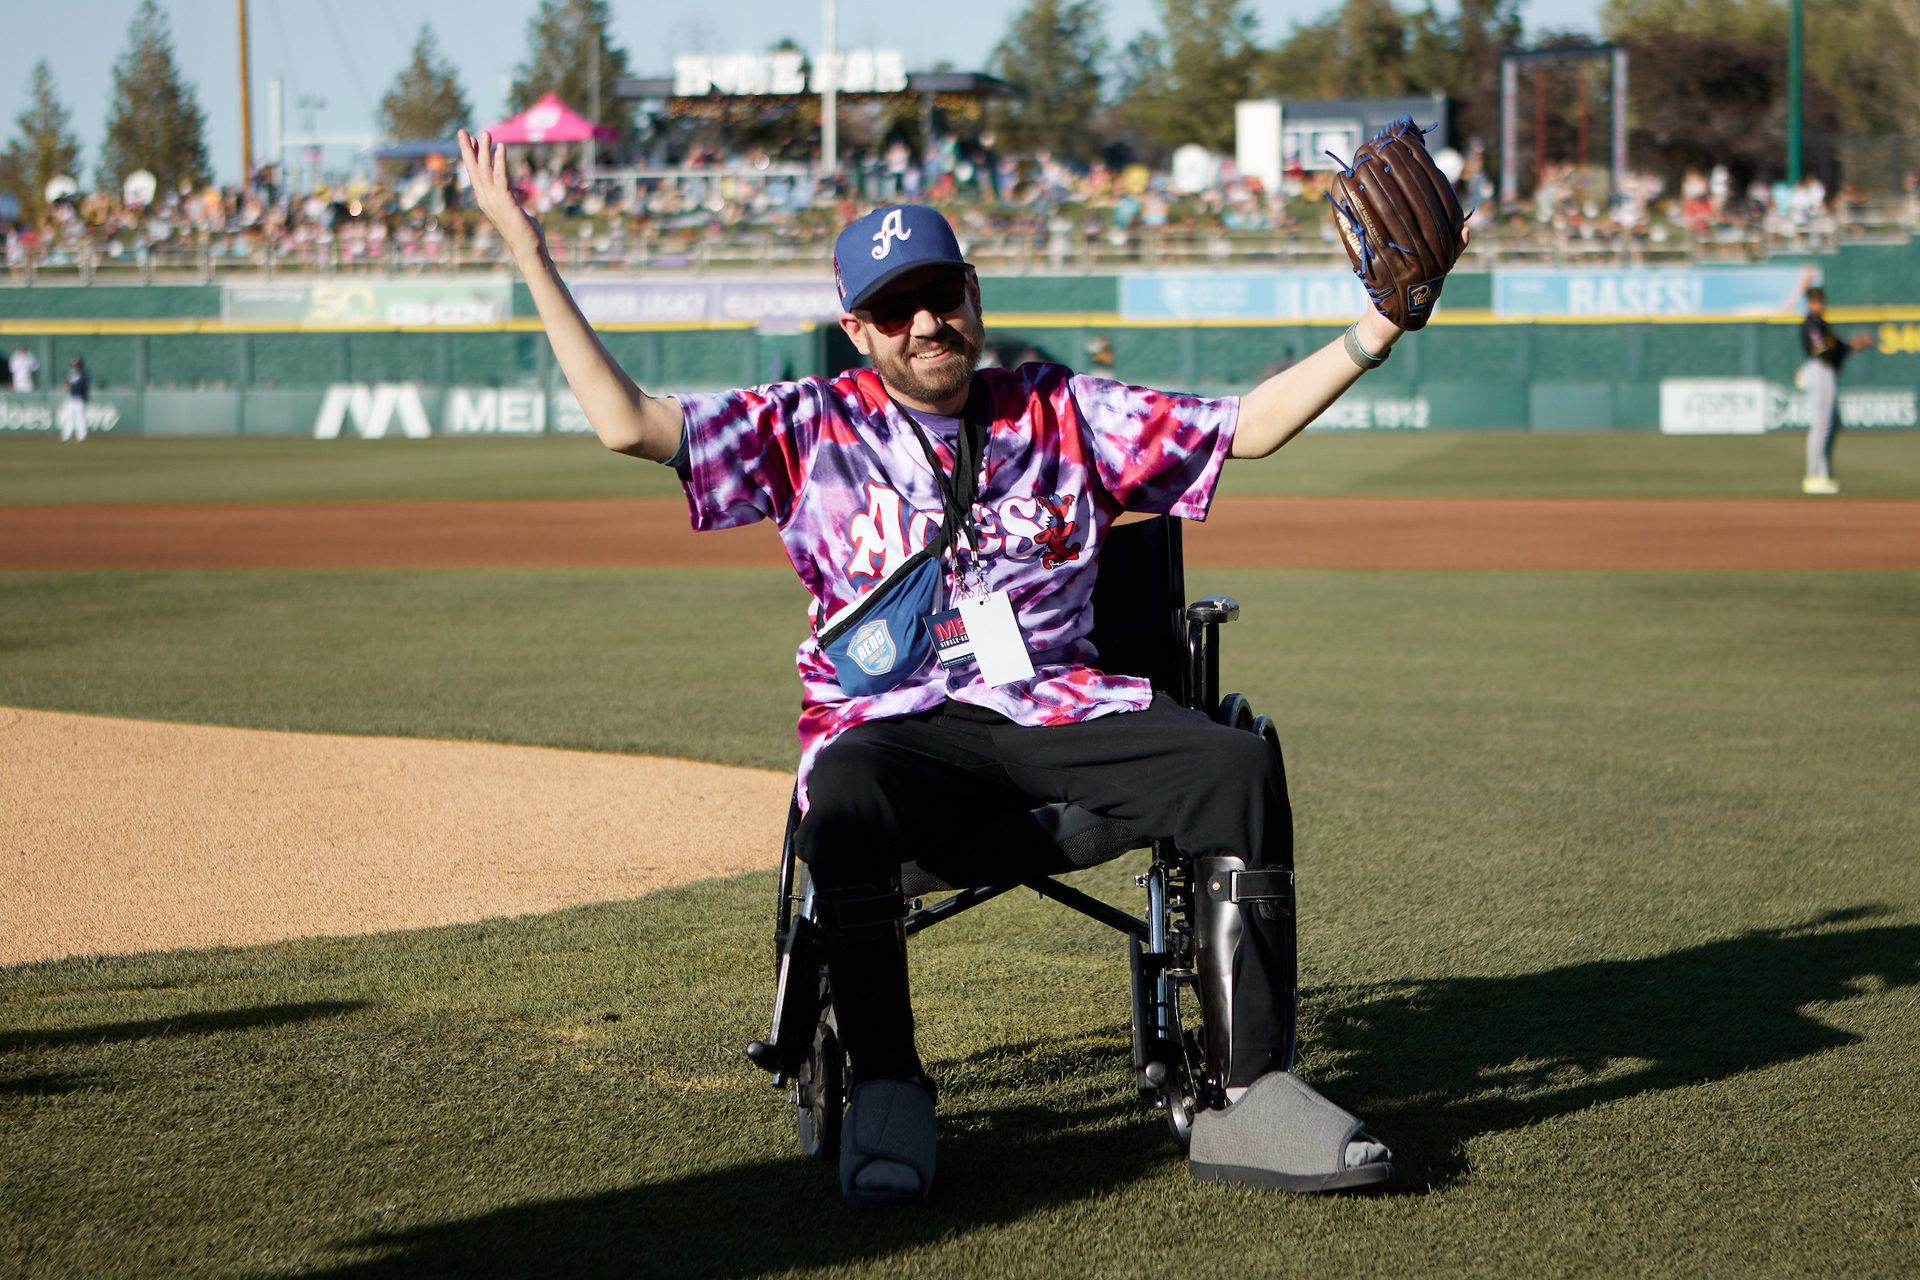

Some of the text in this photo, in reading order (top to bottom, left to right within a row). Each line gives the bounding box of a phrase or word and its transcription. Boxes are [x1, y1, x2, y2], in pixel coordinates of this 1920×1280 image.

[871, 208, 912, 260] A
[1568, 278, 1704, 315] BASES!
[448, 388, 545, 432] MEI
